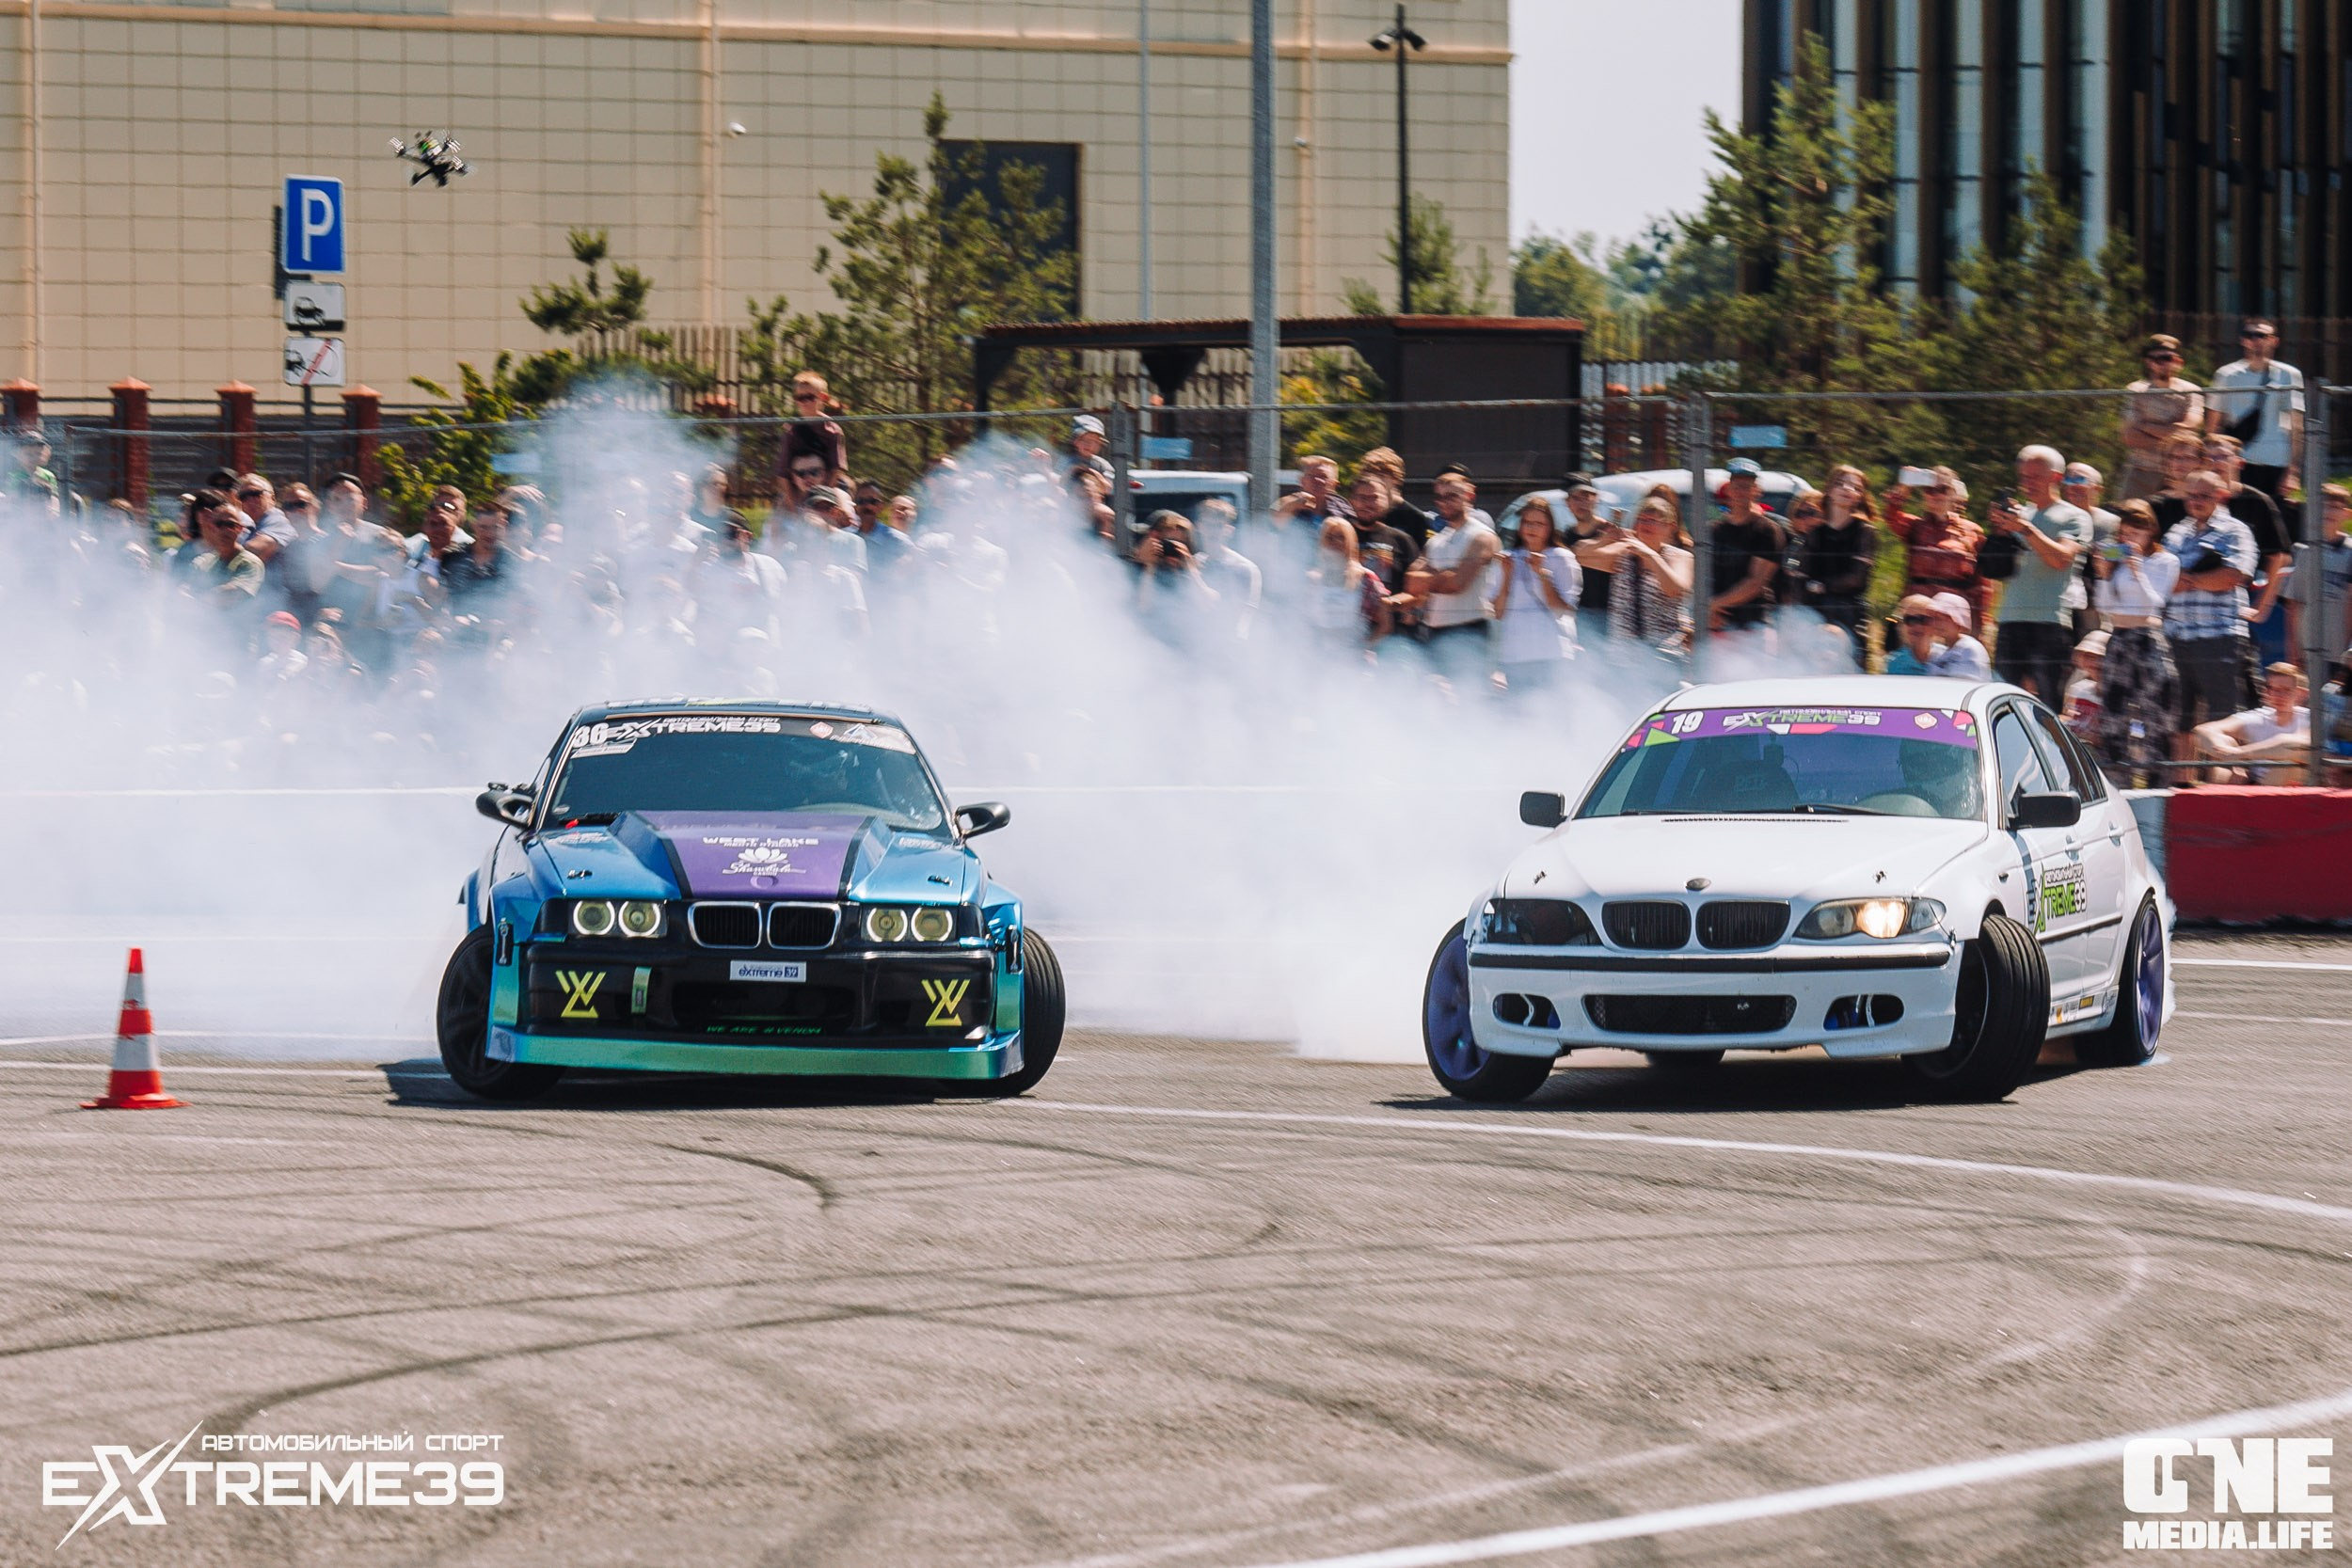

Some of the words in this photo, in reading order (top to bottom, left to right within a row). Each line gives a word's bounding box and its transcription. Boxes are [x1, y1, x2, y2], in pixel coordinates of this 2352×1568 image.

[300, 188, 335, 262] P
[1671, 711, 1704, 734] 19
[739, 964, 783, 978] extreme
